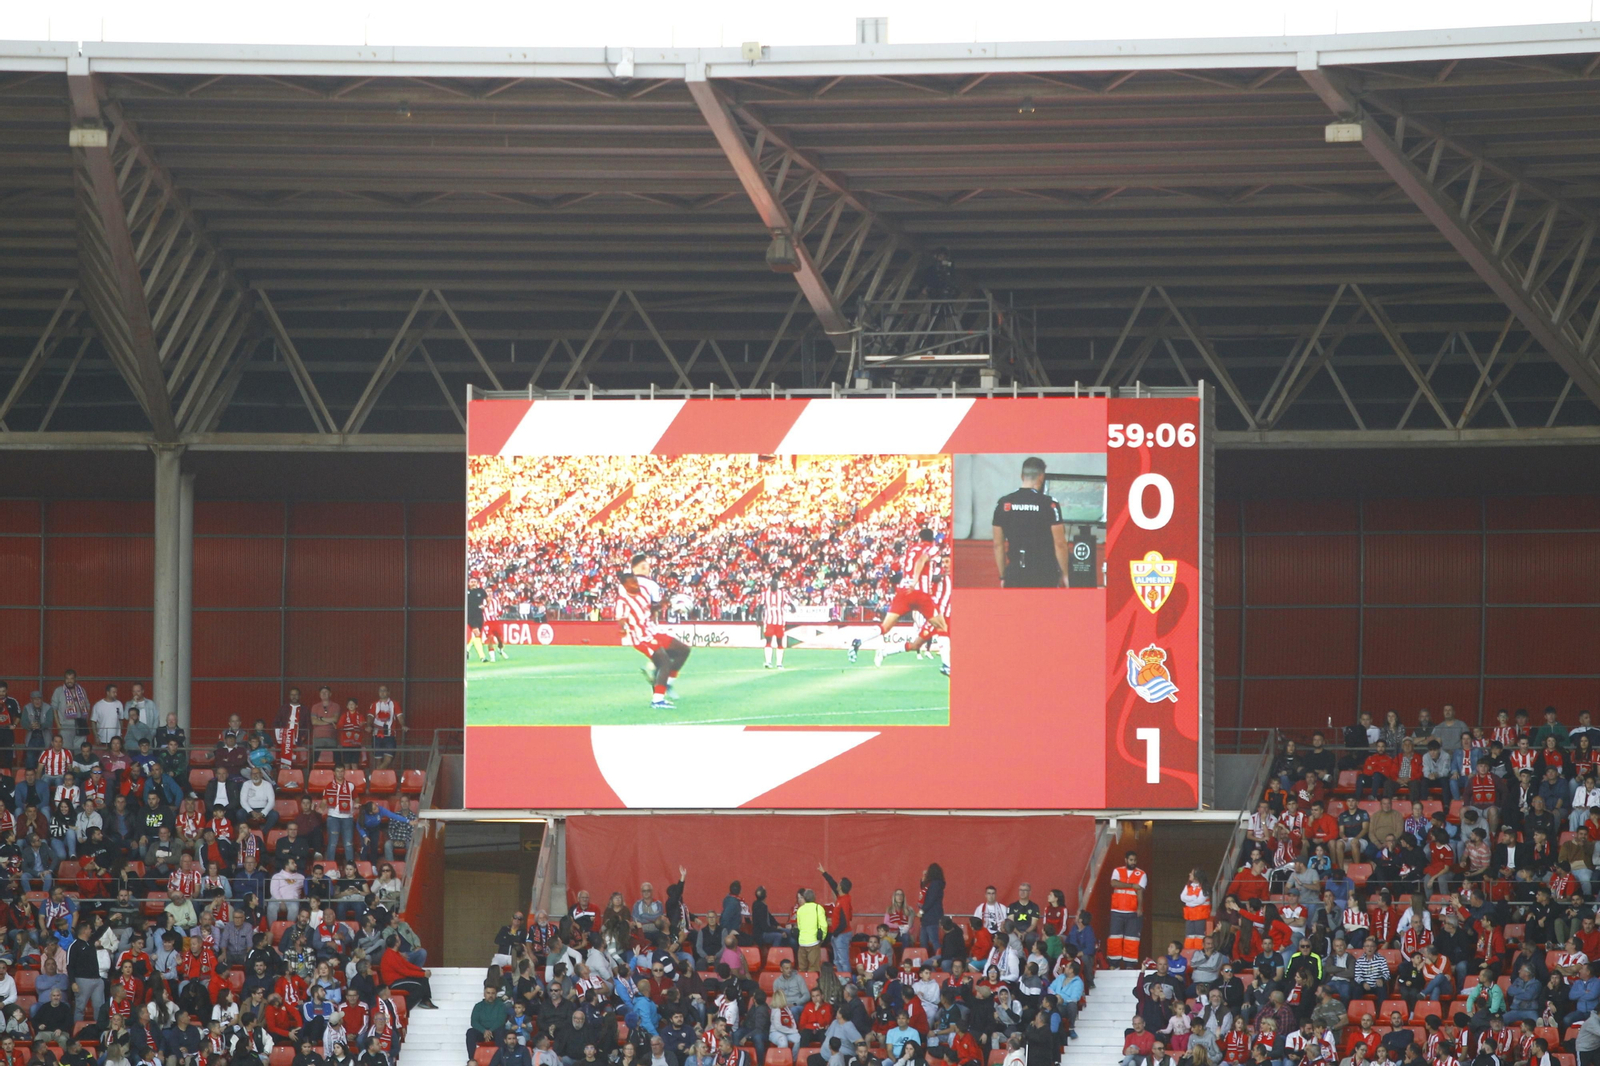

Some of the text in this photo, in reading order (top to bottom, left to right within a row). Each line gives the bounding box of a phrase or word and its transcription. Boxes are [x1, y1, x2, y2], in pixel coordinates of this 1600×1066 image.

[1107, 423, 1196, 448] 59:06
[1128, 473, 1174, 530] 0
[1136, 576, 1171, 584] ALMERIA
[502, 623, 533, 645] IGA
[1136, 727, 1160, 784] 1
